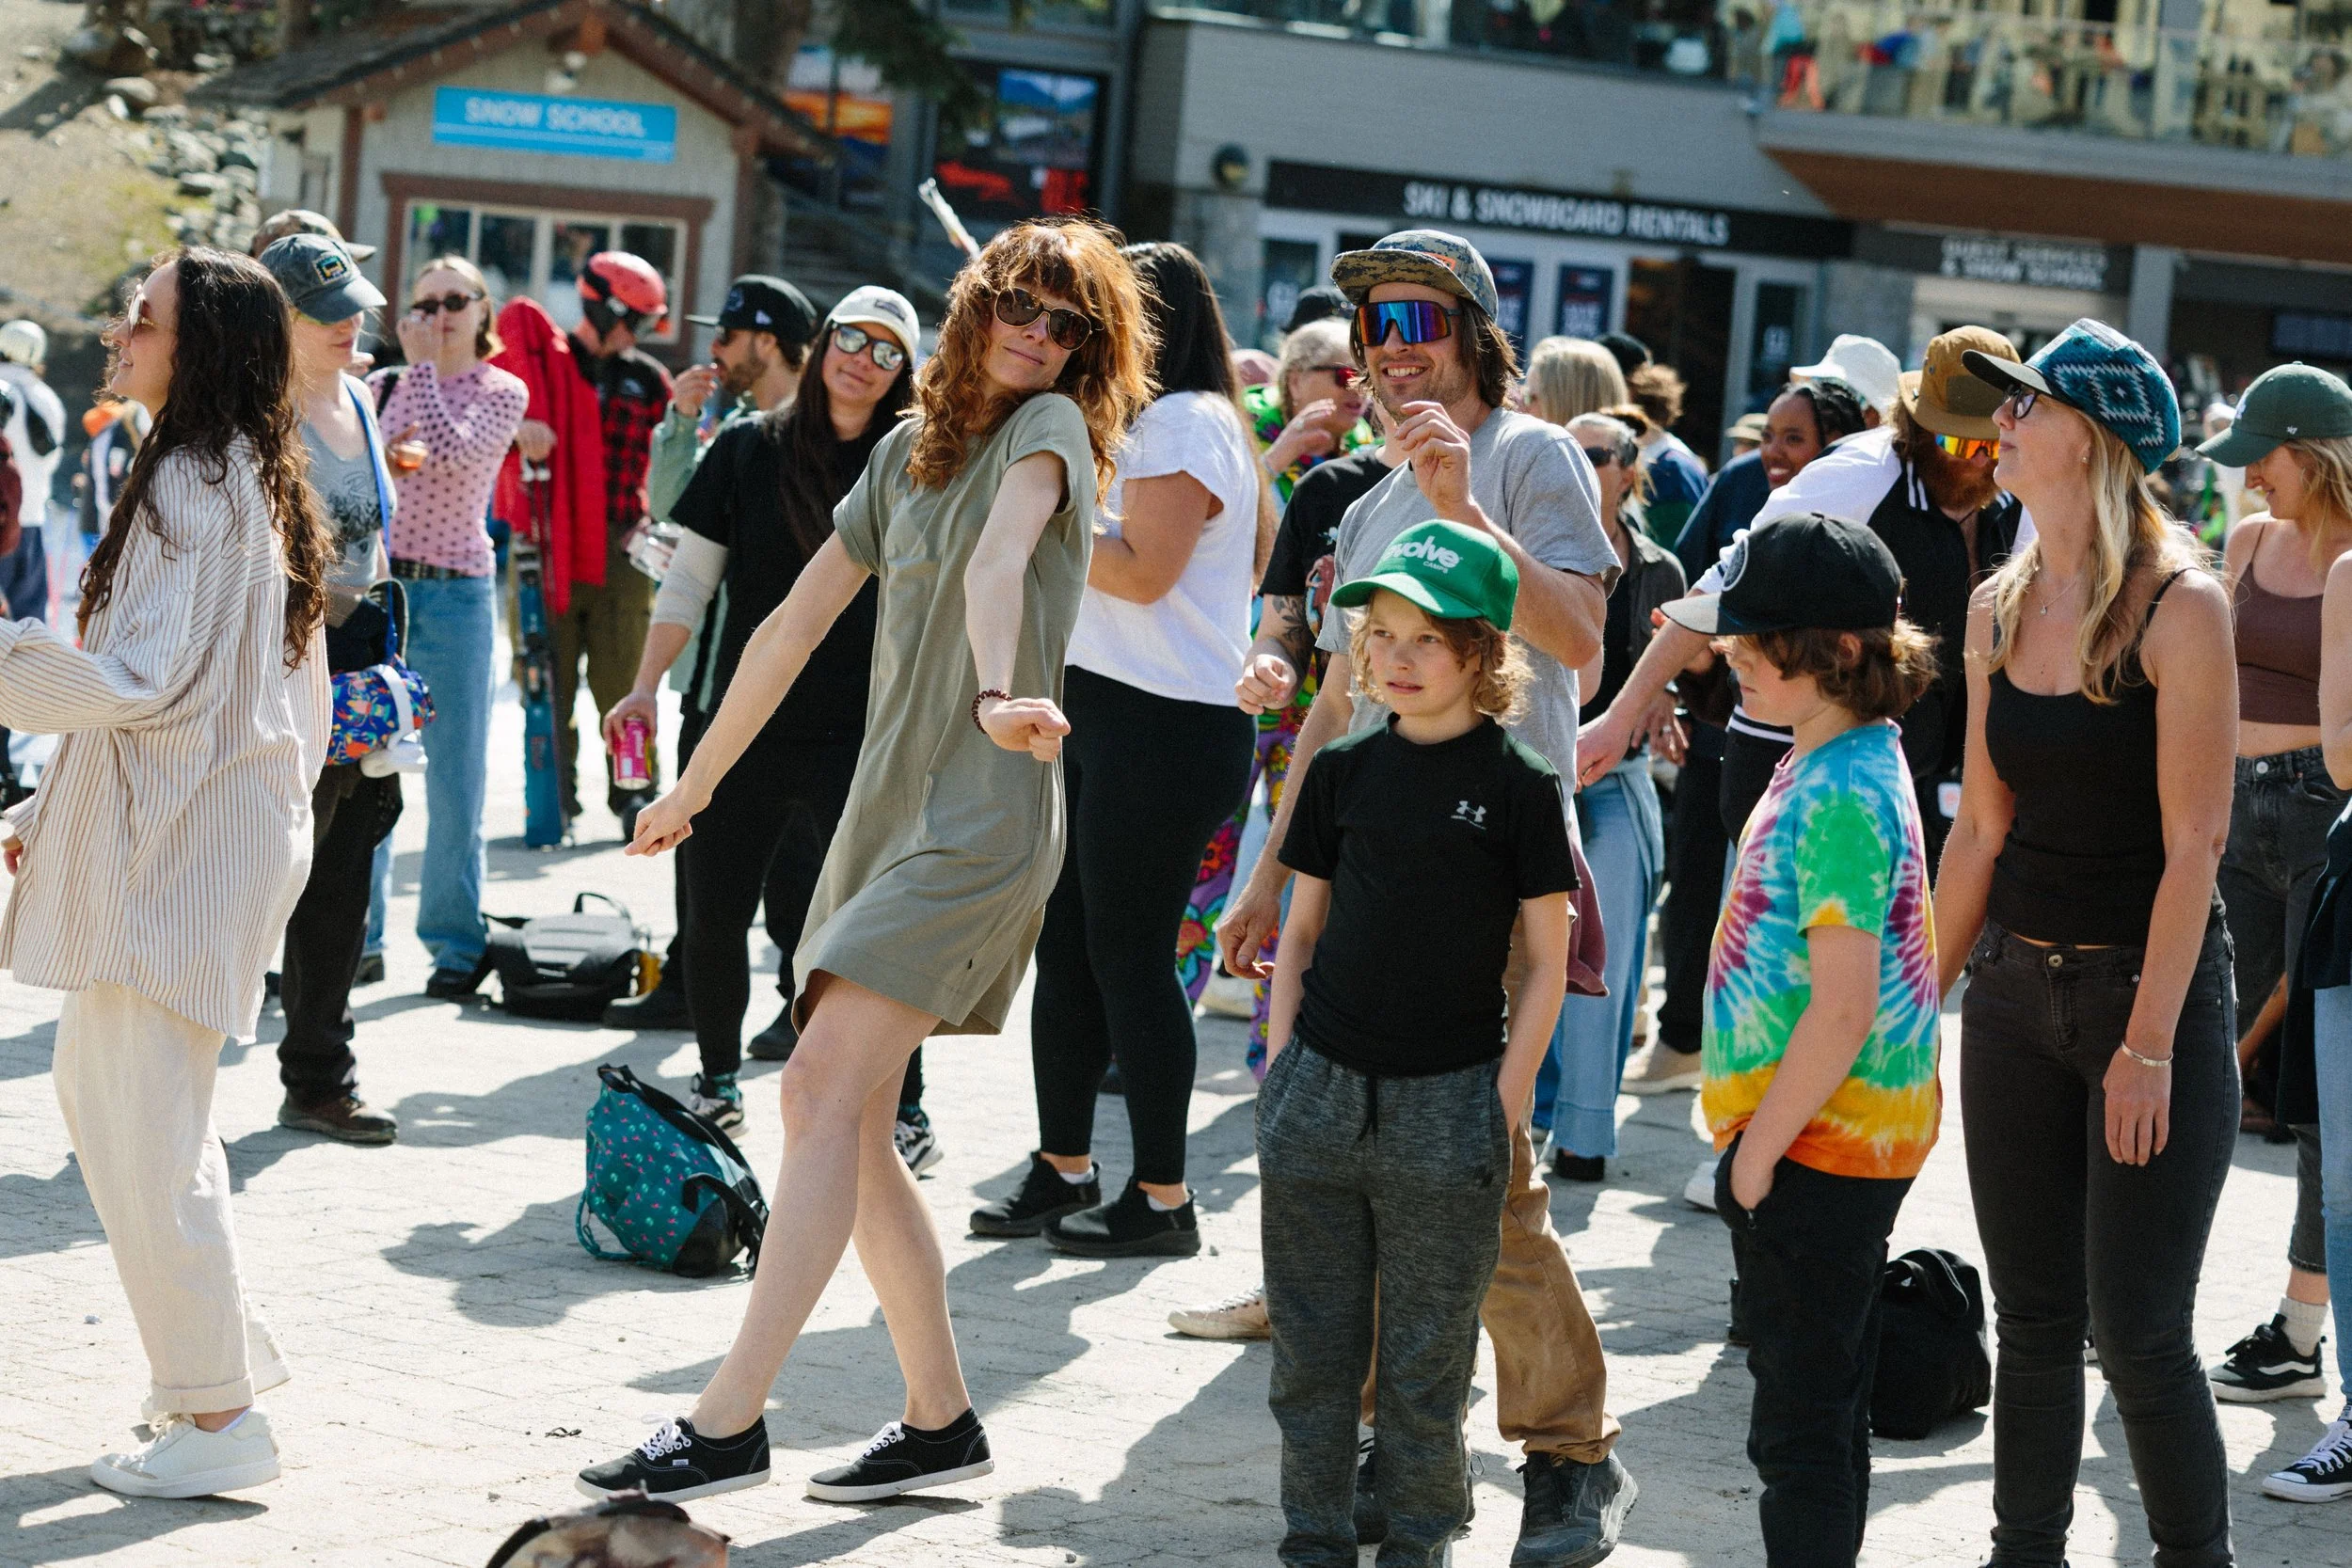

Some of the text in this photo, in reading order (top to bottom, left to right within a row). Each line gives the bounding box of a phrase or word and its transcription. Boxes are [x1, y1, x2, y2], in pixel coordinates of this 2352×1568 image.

[466, 98, 646, 138] SNOW SCHOOL
[1405, 182, 1729, 246] SKI & SNOWBOARD RENTALS
